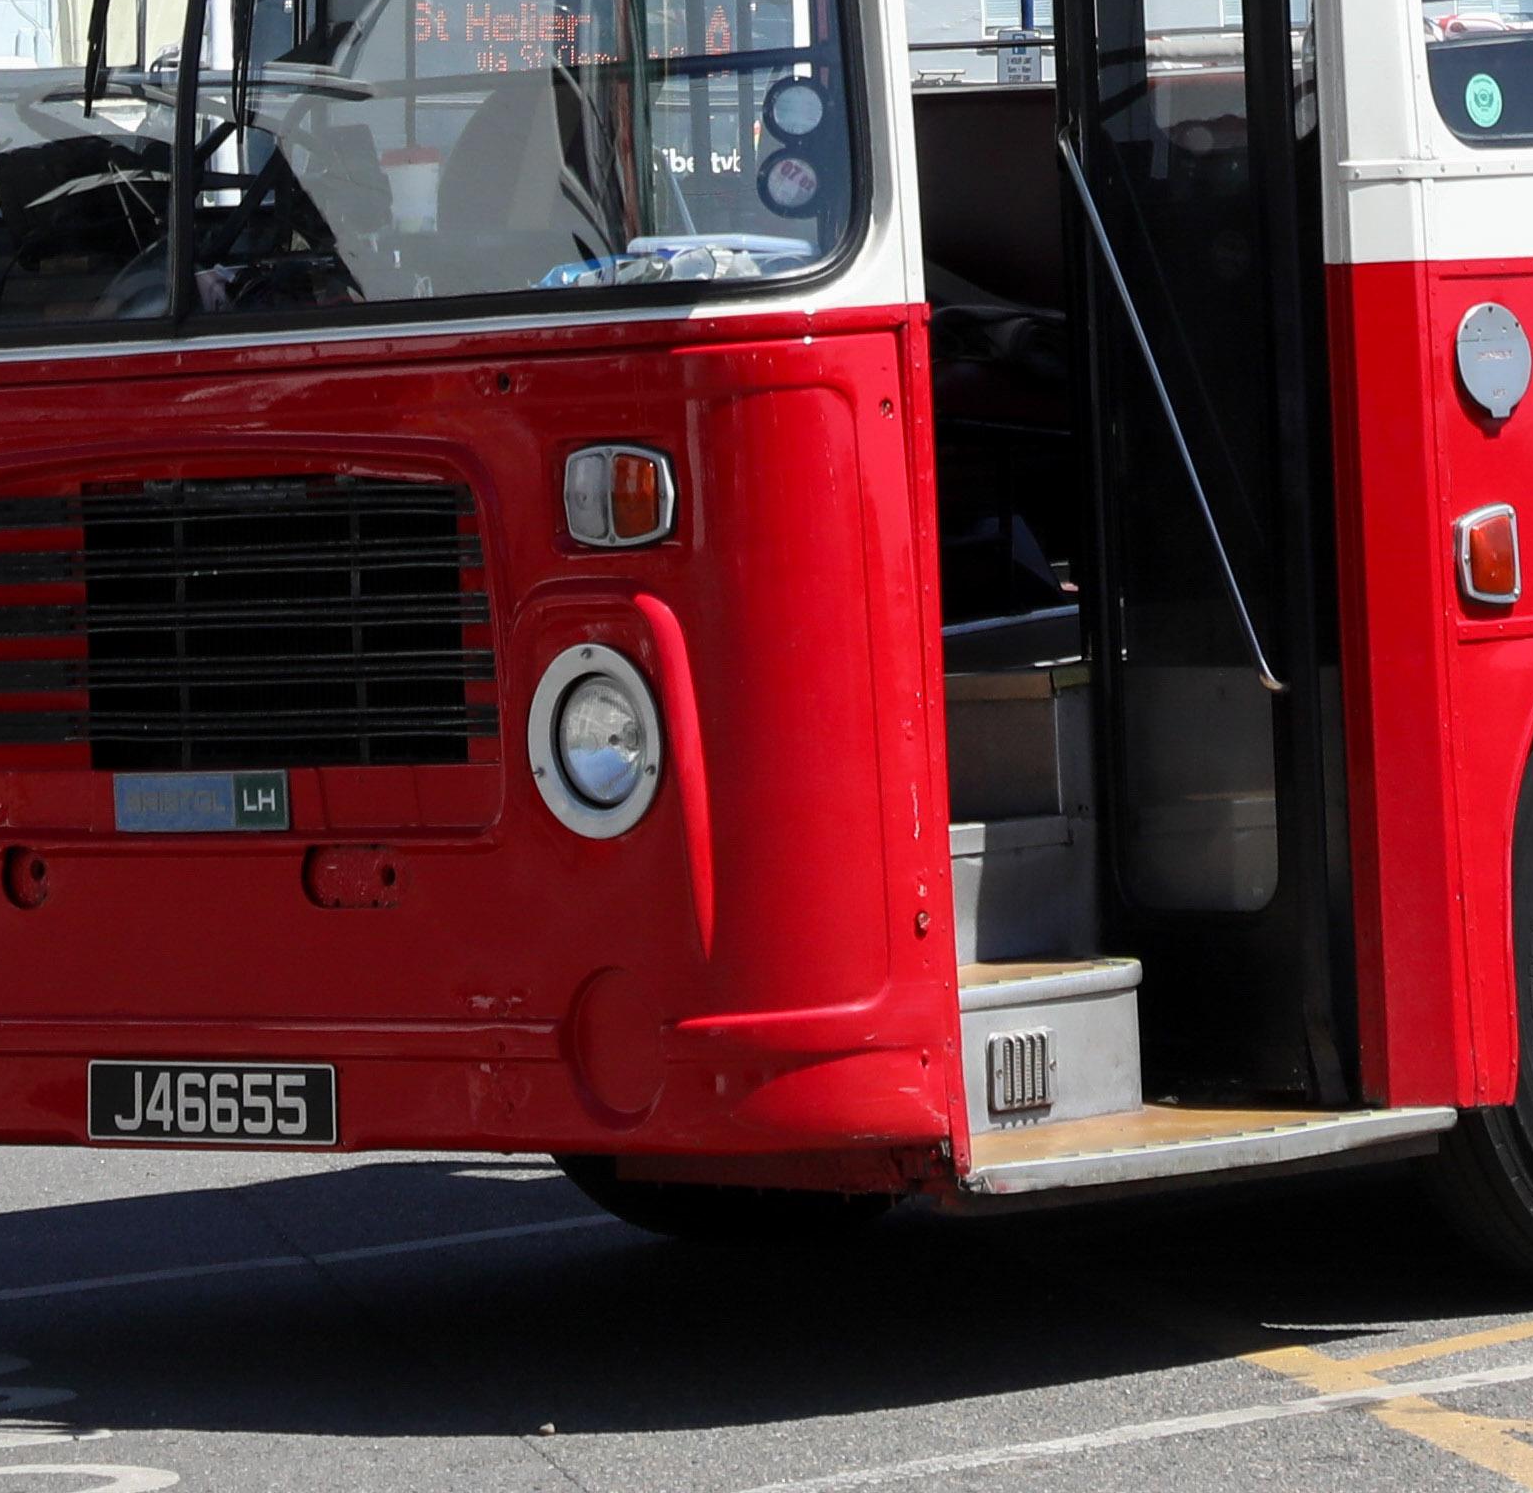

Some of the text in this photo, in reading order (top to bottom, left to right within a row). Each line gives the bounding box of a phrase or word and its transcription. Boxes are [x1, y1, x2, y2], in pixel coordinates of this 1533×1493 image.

[465, 2, 593, 42] Helier
[243, 788, 275, 811] LH
[114, 1071, 308, 1133] J46655
